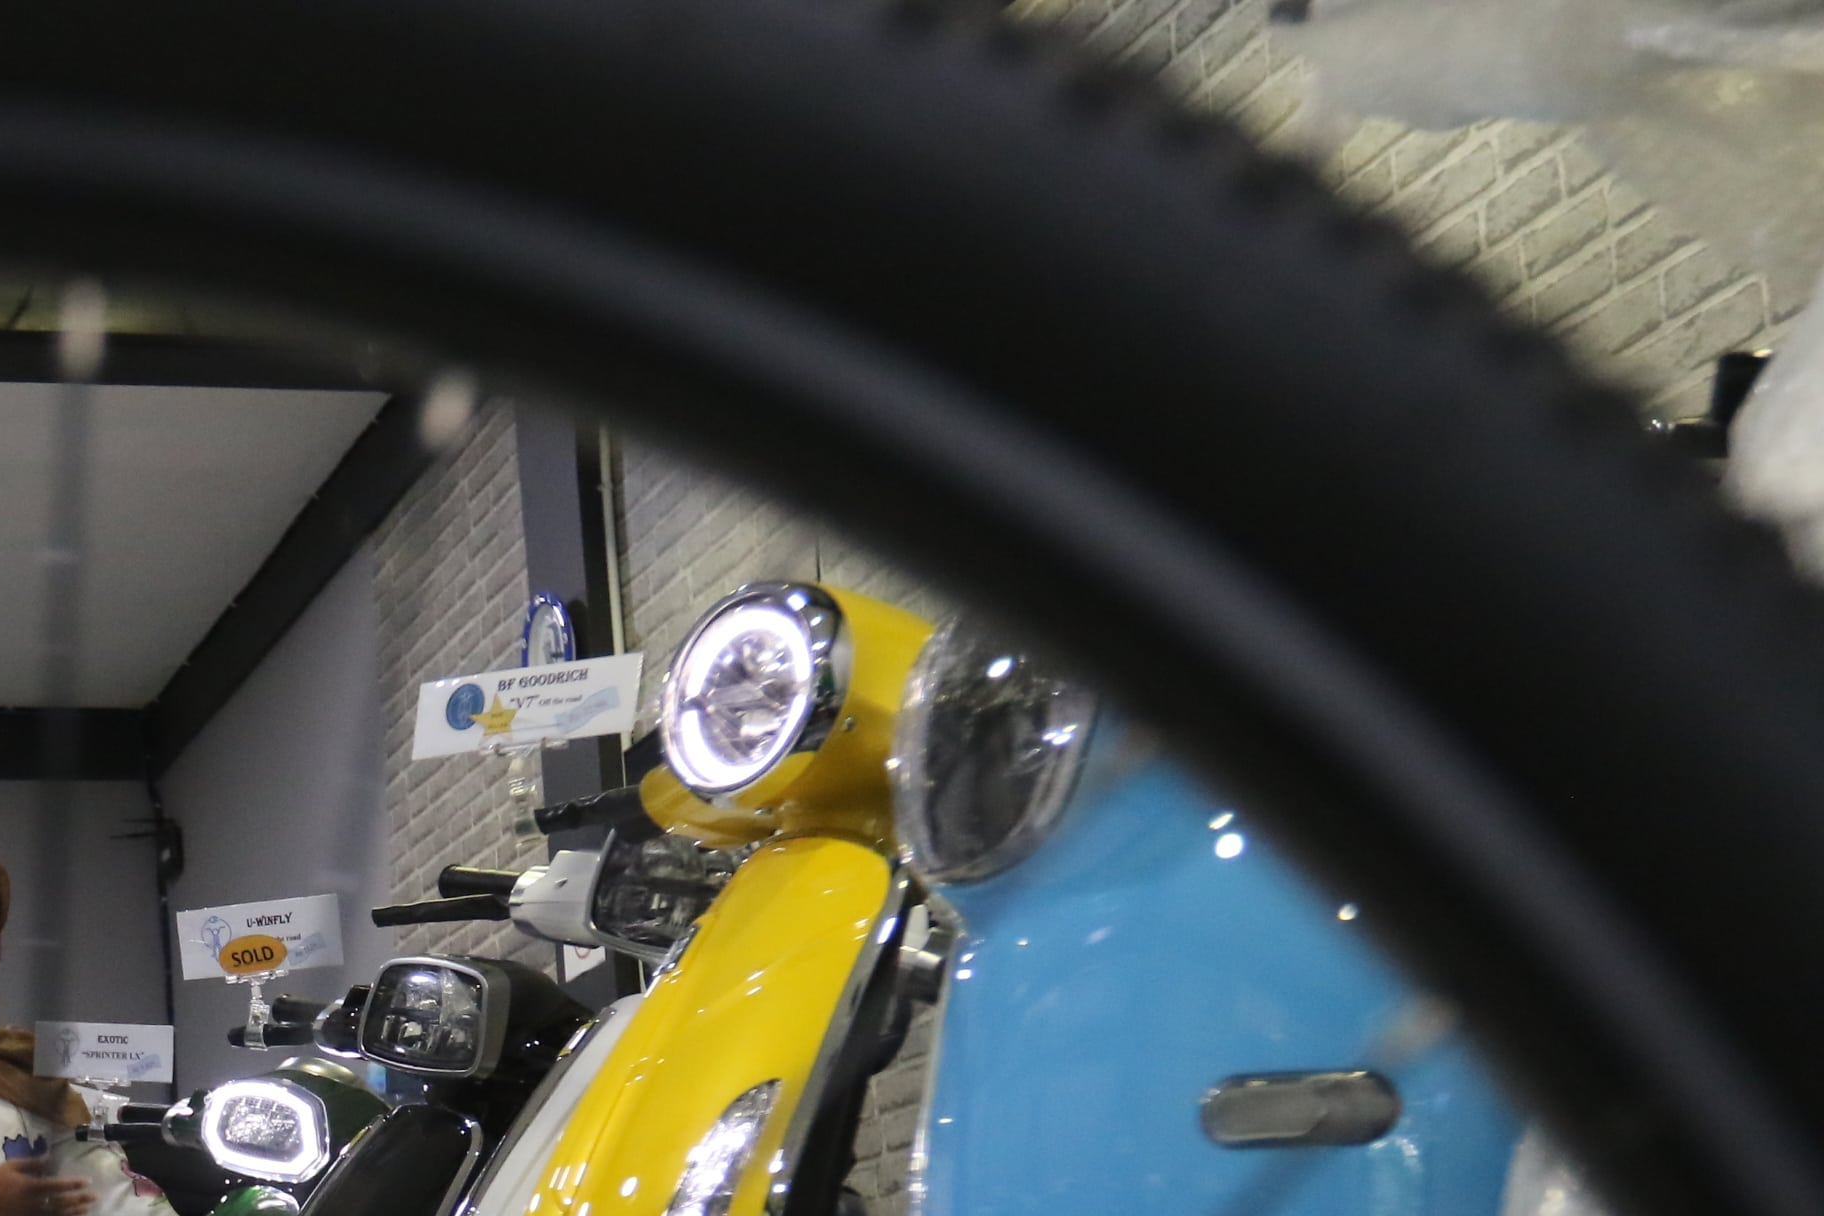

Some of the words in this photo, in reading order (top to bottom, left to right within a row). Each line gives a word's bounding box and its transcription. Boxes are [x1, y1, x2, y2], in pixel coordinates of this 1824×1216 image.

[246, 911, 293, 928] U-WINFLY
[231, 945, 274, 968] SOLD
[97, 1035, 129, 1045] EXOTIC
